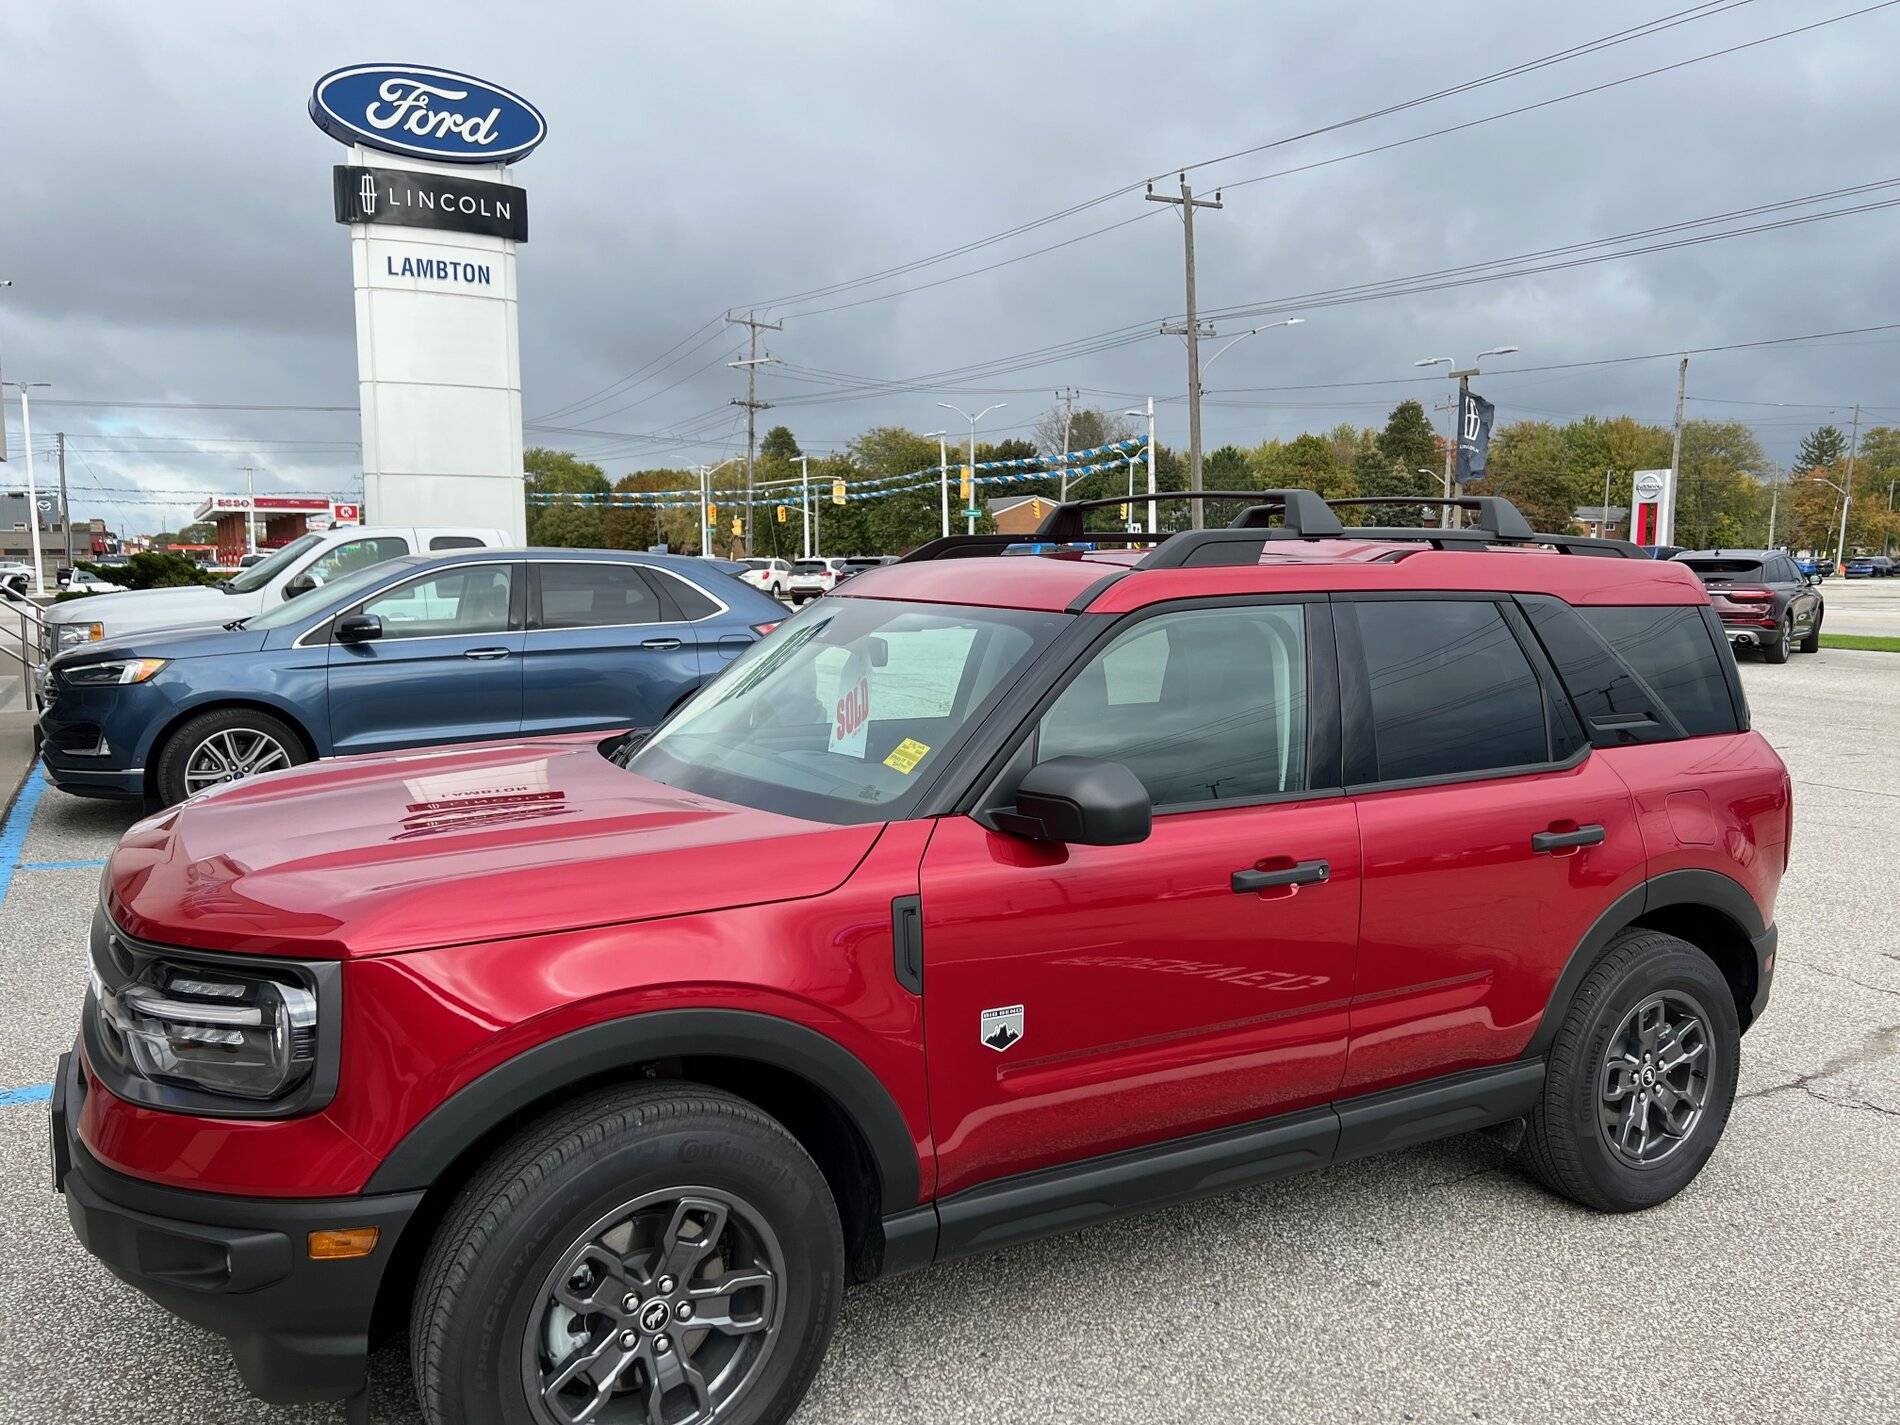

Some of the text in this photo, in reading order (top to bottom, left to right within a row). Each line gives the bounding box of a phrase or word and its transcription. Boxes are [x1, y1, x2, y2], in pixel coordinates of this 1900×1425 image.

[365, 77, 501, 145] Ford
[389, 187, 512, 220] LINCOLN
[387, 255, 491, 284] LAMBTON
[836, 677, 870, 741] SOLD
